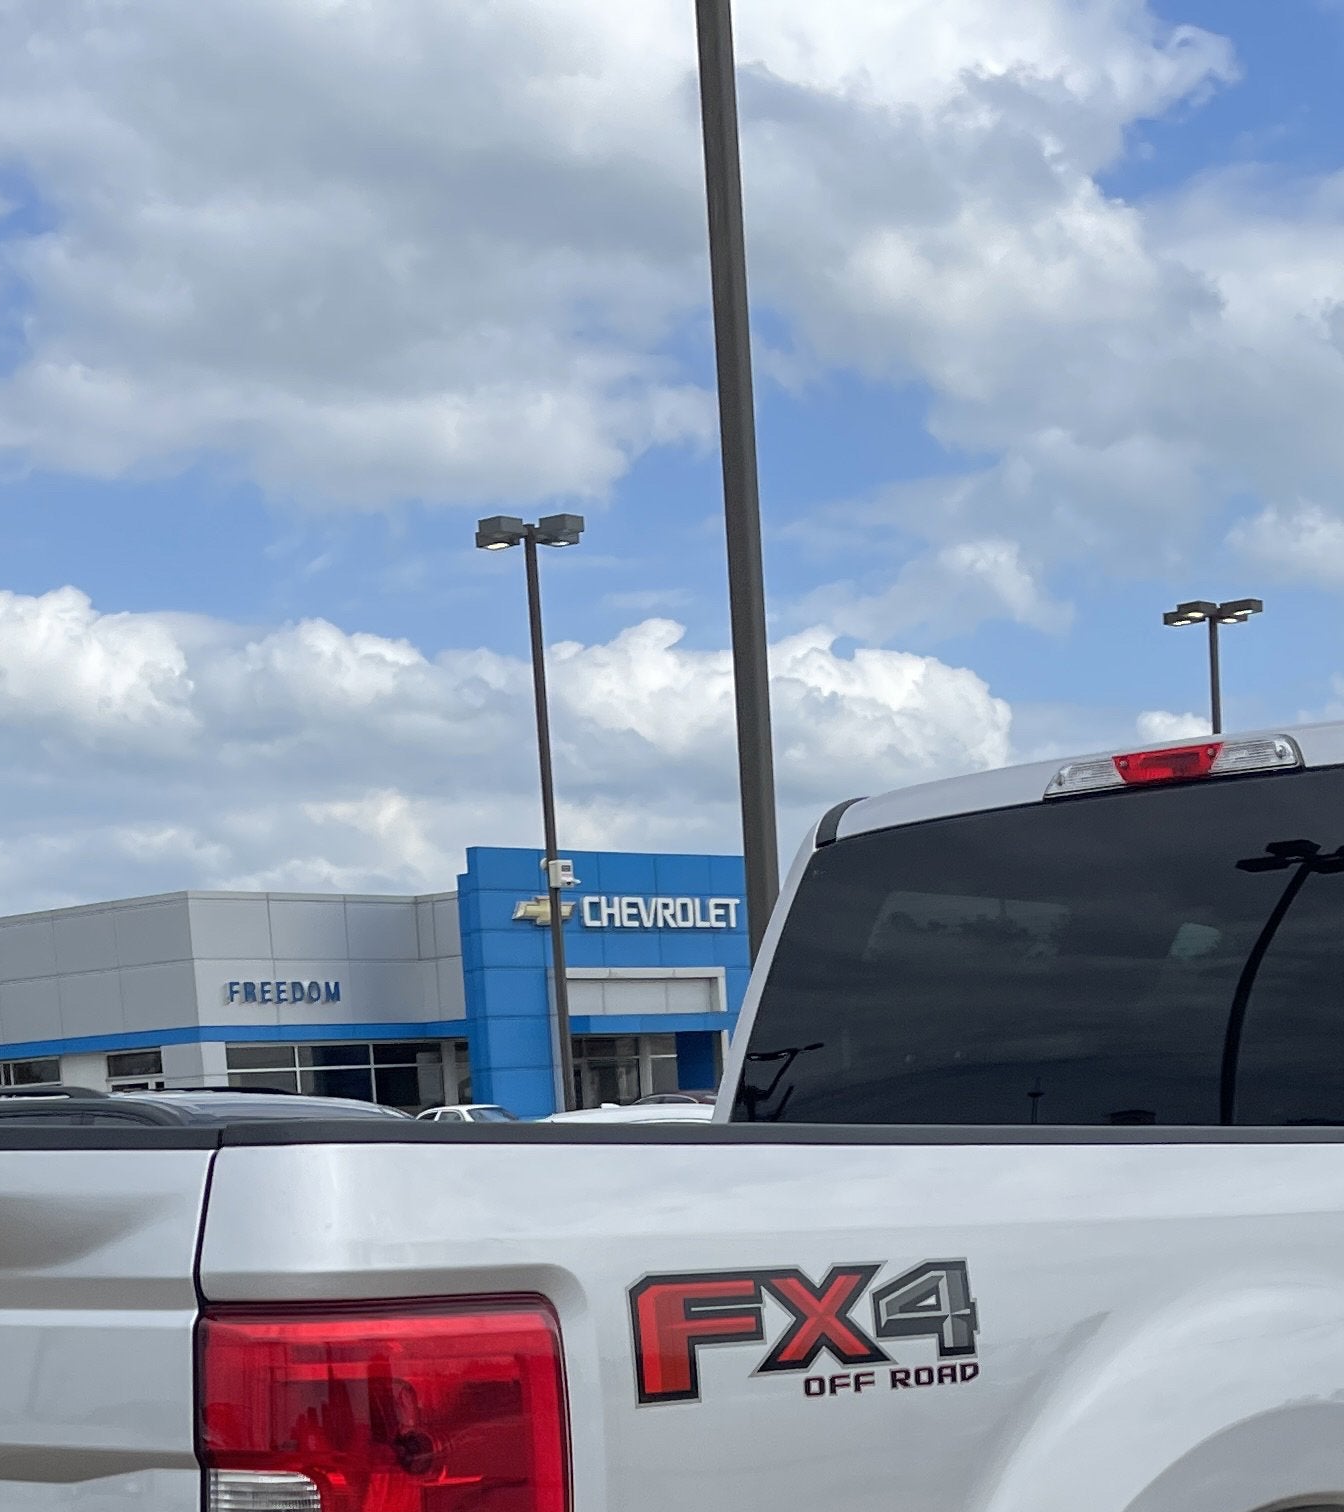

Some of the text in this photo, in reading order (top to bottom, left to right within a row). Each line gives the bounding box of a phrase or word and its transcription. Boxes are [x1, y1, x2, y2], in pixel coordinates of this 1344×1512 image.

[582, 895, 741, 928] CHEVROLET
[227, 980, 341, 1004] FREEDOM
[625, 1257, 979, 1409] FX4
[804, 1362, 979, 1398] OFF ROAD
